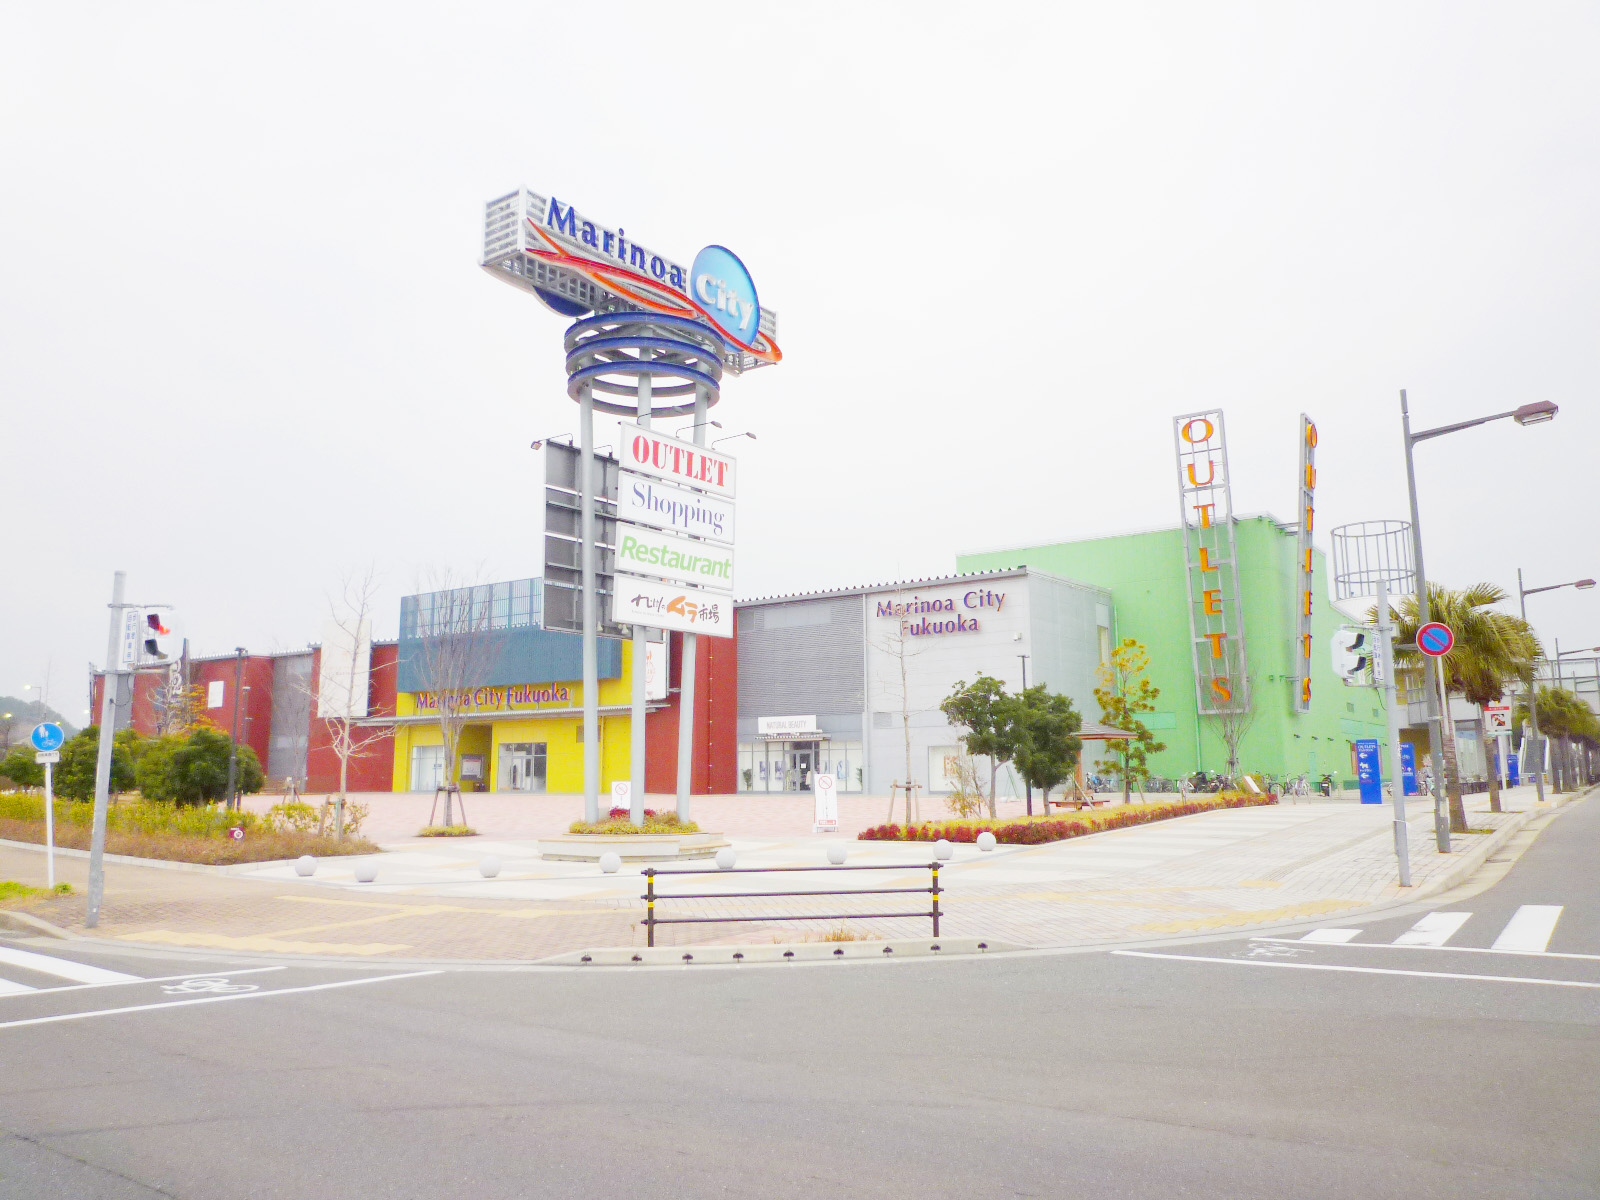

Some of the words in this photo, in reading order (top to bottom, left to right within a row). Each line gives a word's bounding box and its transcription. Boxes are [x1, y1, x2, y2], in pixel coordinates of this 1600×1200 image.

[547, 196, 684, 289] Marinoa
[695, 273, 755, 331] City
[632, 435, 728, 487] OUTLET
[631, 482, 725, 536] Shopping
[620, 536, 731, 579] Restaurant
[1181, 418, 1232, 702] OUTLETS
[876, 596, 955, 618] Marinoa
[963, 588, 1006, 612] City
[901, 613, 979, 637] Fukuoka
[474, 687, 503, 710] City
[506, 682, 570, 704] Fukuoka
